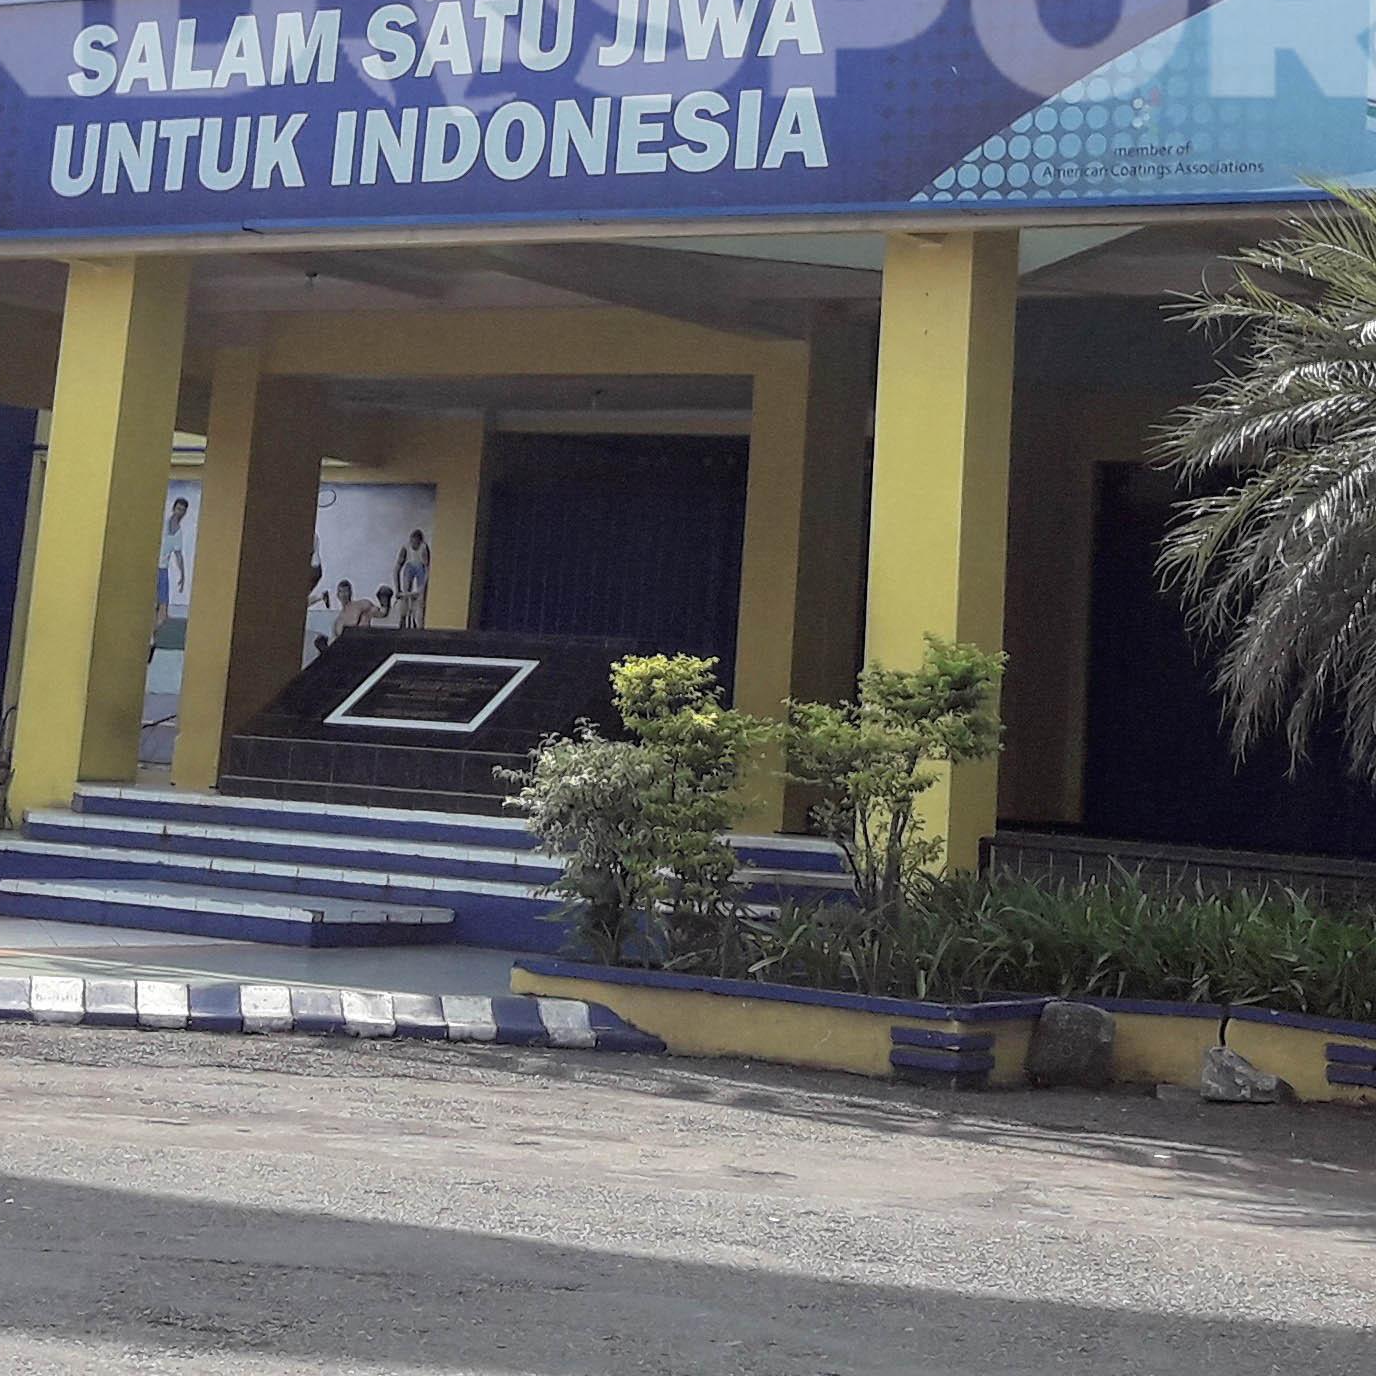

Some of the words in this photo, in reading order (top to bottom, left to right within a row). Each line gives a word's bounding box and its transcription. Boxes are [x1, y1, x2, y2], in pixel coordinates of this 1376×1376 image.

[67, 8, 342, 97] SALAM
[50, 112, 309, 197] UNTUK
[330, 86, 828, 186] INDONESIA
[1114, 144, 1173, 157] member
[1176, 141, 1192, 155] of
[1042, 165, 1108, 179] American
[1110, 163, 1171, 179] Coatings
[1176, 160, 1265, 175] Associations
